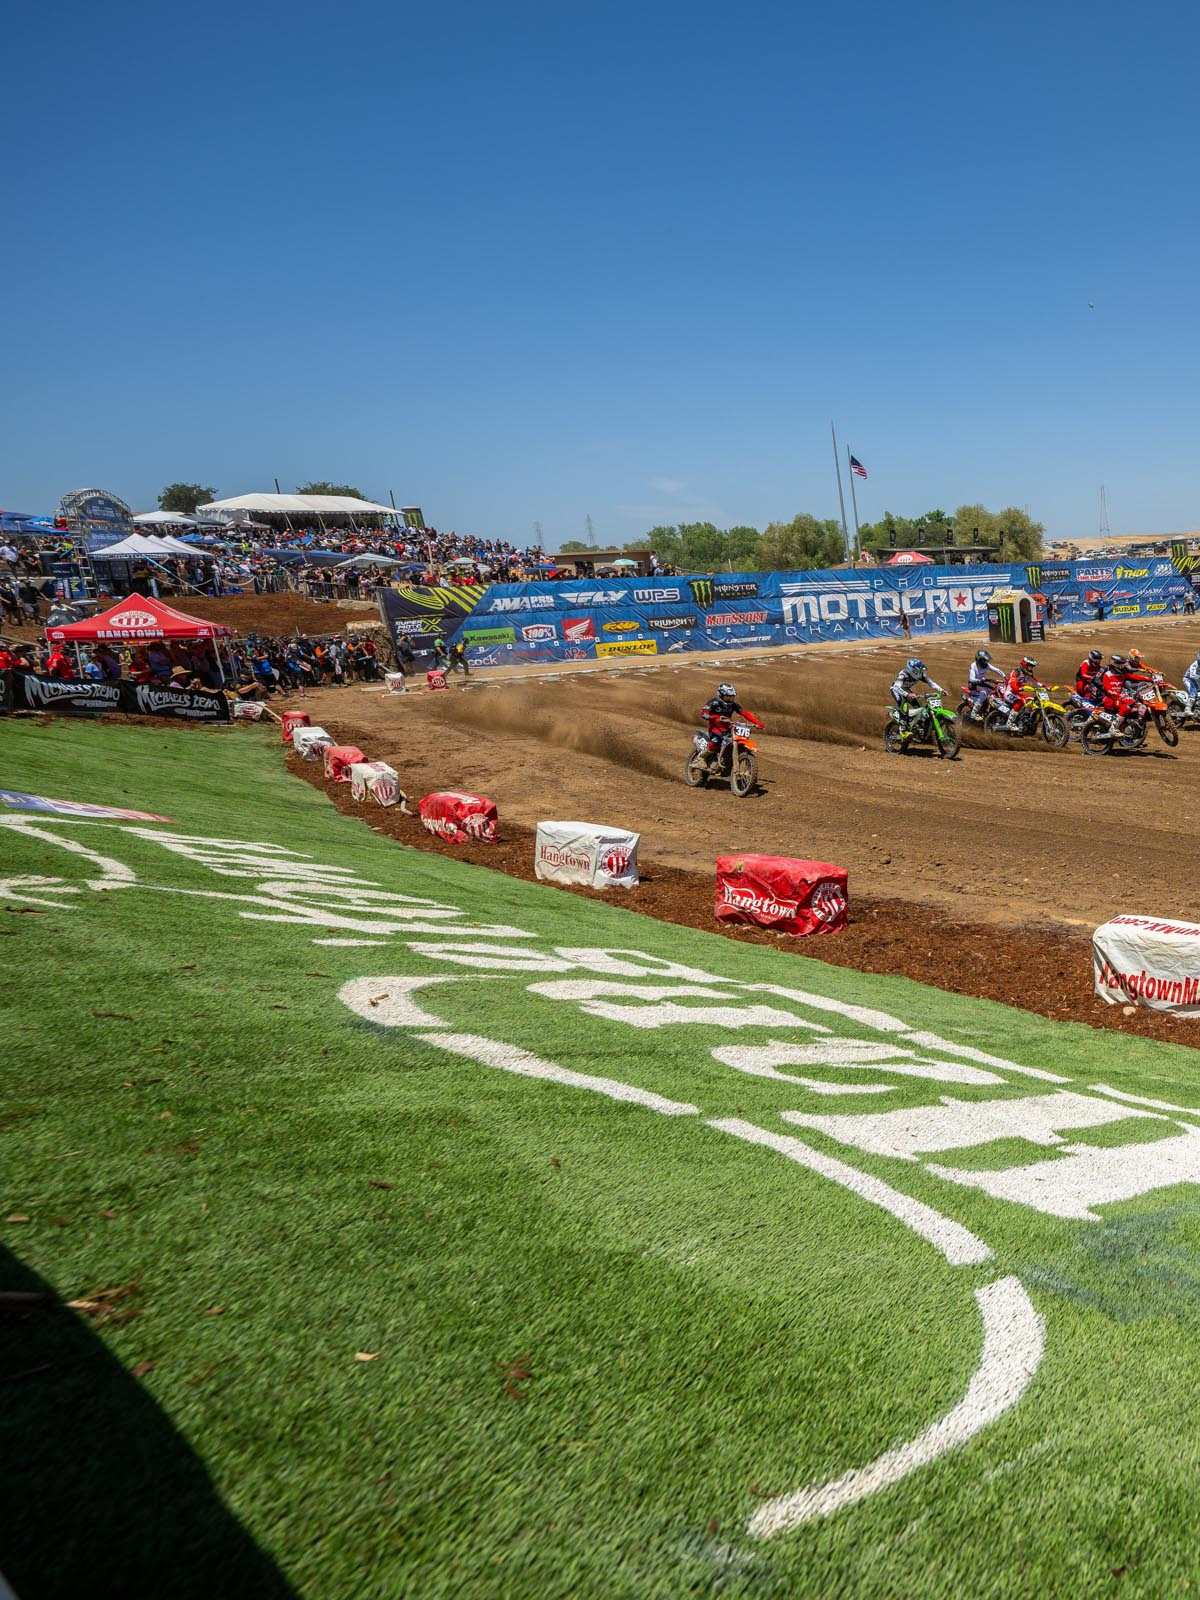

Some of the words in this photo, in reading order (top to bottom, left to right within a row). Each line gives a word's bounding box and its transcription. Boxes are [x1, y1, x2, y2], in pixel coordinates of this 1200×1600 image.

[1076, 567, 1114, 576] PARTS
[714, 583, 757, 593] MONSTER
[874, 576, 934, 589] PRO
[530, 595, 554, 604] PRO
[634, 588, 680, 602] WPS
[488, 597, 531, 612] AMA
[782, 585, 1013, 624] MOTOCROS
[649, 617, 687, 628] TRIUMPH
[97, 629, 164, 638] HANGTOWN
[469, 632, 510, 642] Kawasaki
[526, 627, 552, 638] 100%
[608, 643, 654, 653] DUNLOP
[735, 726, 751, 737] 376
[540, 843, 591, 872] Hangtown
